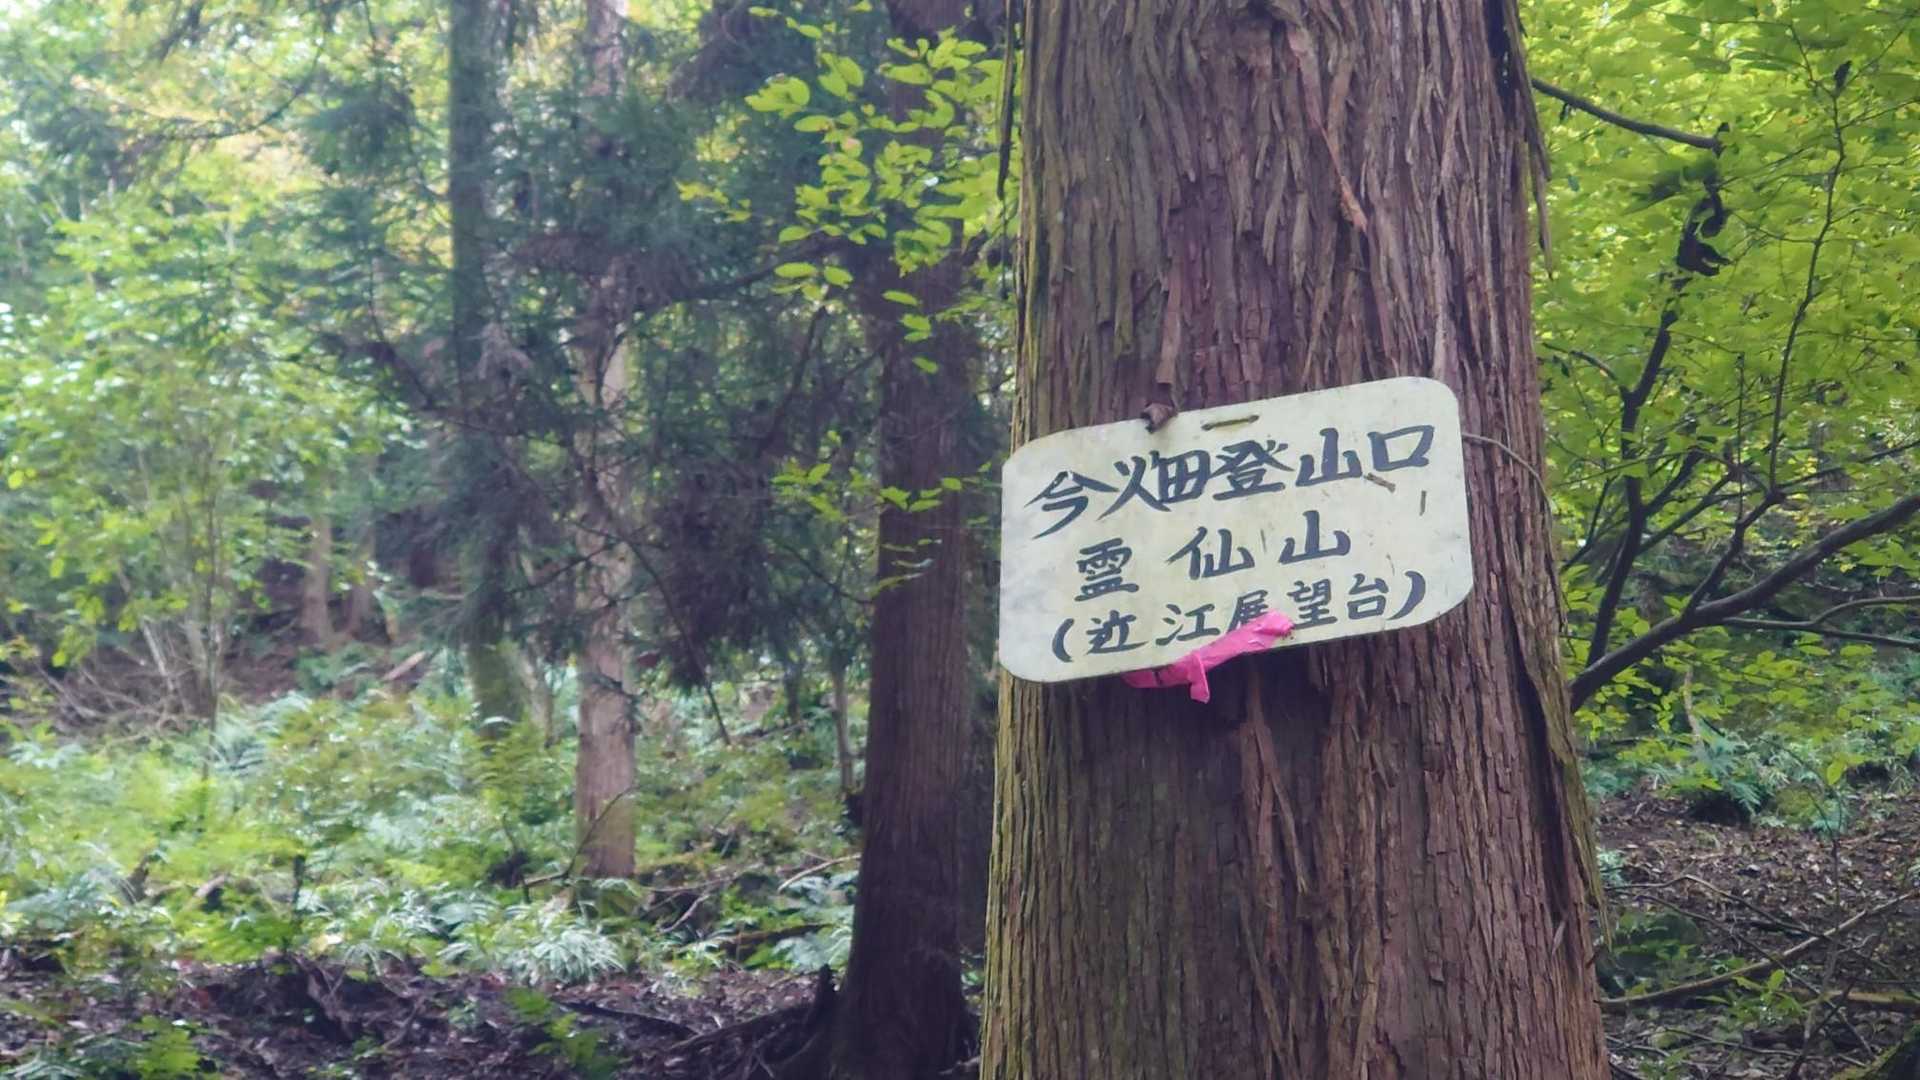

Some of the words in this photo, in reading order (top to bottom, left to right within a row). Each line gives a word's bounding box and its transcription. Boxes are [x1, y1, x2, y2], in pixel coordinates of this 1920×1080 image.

[1024, 424, 1434, 539] 今畑登山口
